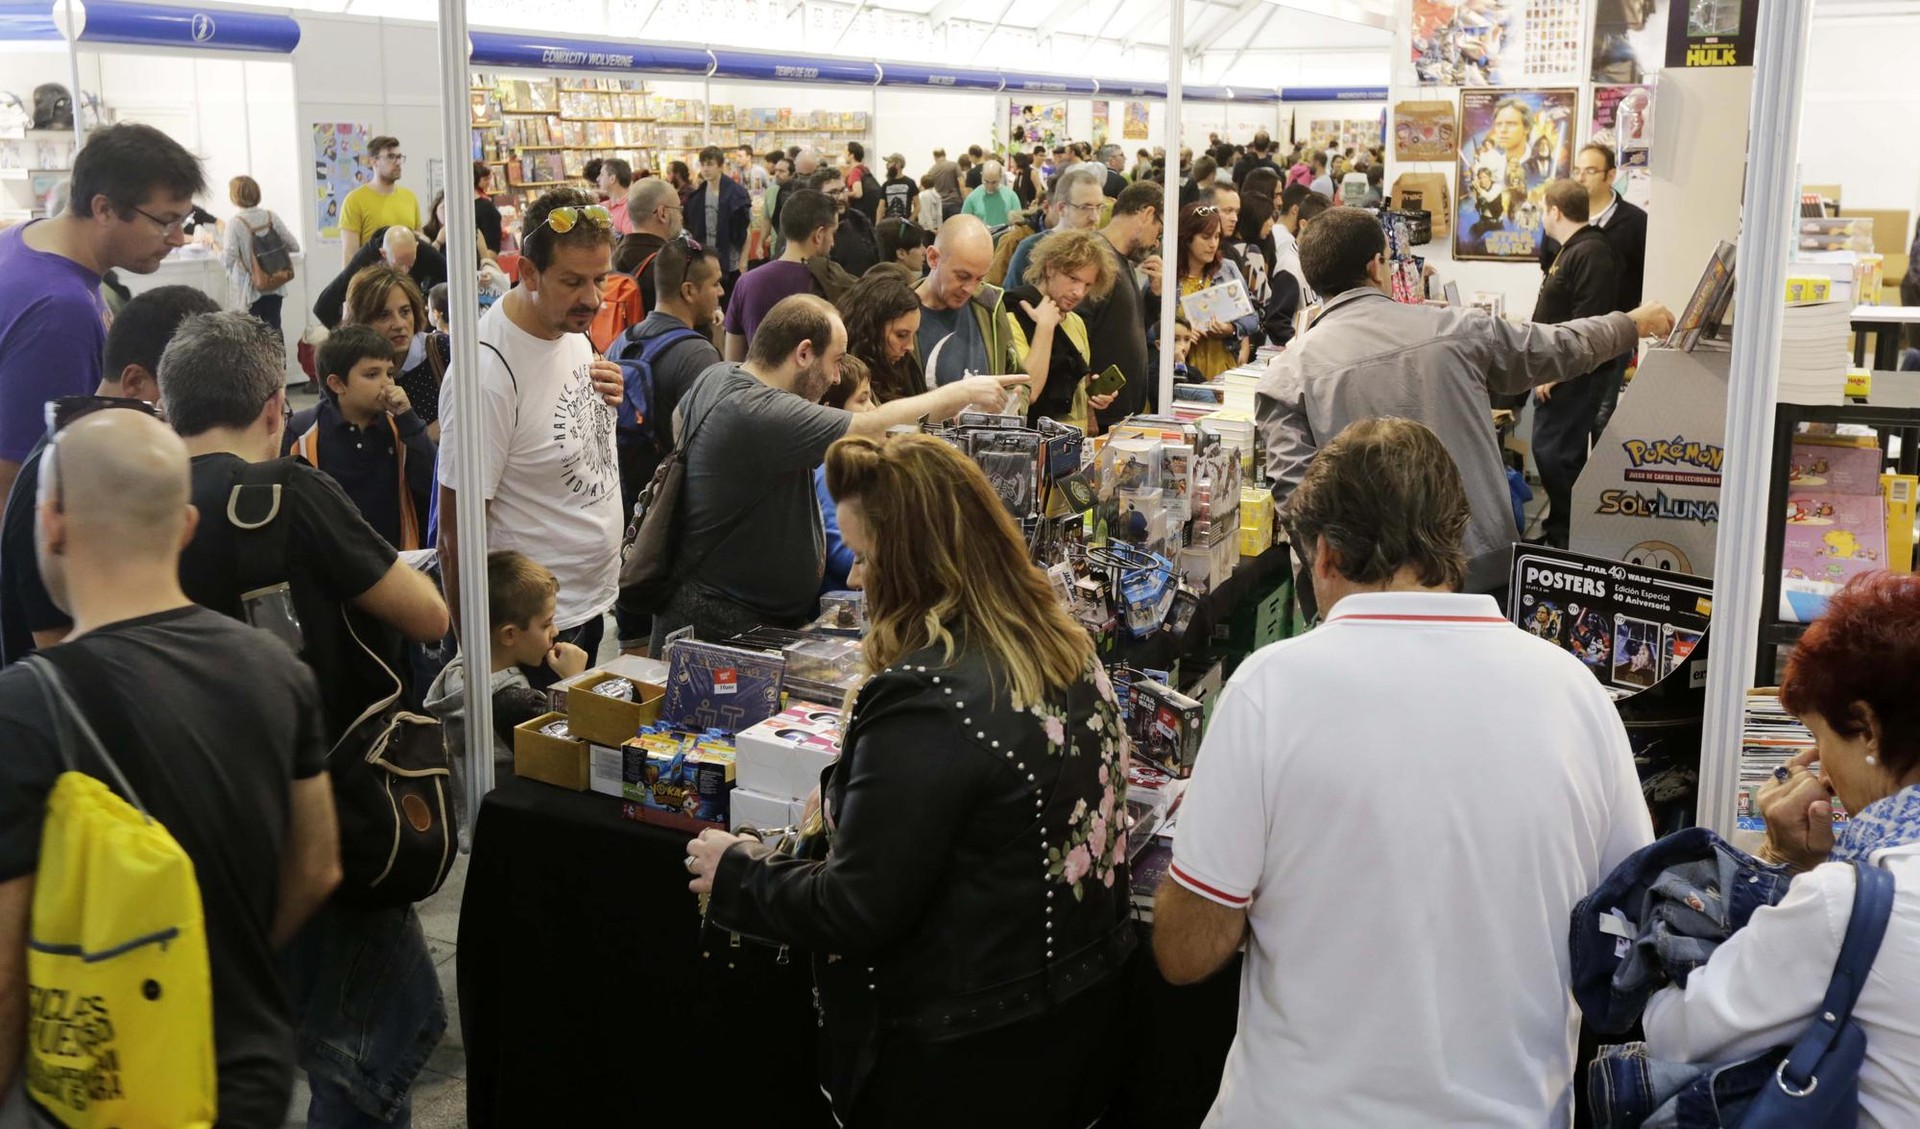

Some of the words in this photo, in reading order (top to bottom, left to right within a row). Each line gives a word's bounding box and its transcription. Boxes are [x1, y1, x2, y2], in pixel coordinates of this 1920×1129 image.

[542, 50, 588, 65] COMIXCITY
[588, 53, 633, 68] WOLVERINE
[1686, 49, 1736, 66] HULK
[1628, 471, 1645, 479] JUEGO
[1654, 473, 1674, 481] CARTAS
[1674, 475, 1720, 485] COLECCIONABLES
[1595, 489, 1651, 517] SOL
[1656, 487, 1719, 523] LUNA
[1526, 567, 1606, 598] POSTERS
[1584, 565, 1608, 575] STAR
[1627, 573, 1652, 584] WARS
[1614, 583, 1640, 596] Edición
[1641, 589, 1671, 602] Especial
[1613, 593, 1624, 602] 40
[1625, 596, 1671, 612] Aniversario
[1138, 699, 1155, 712] WARS
[1139, 693, 1156, 705] STAR
